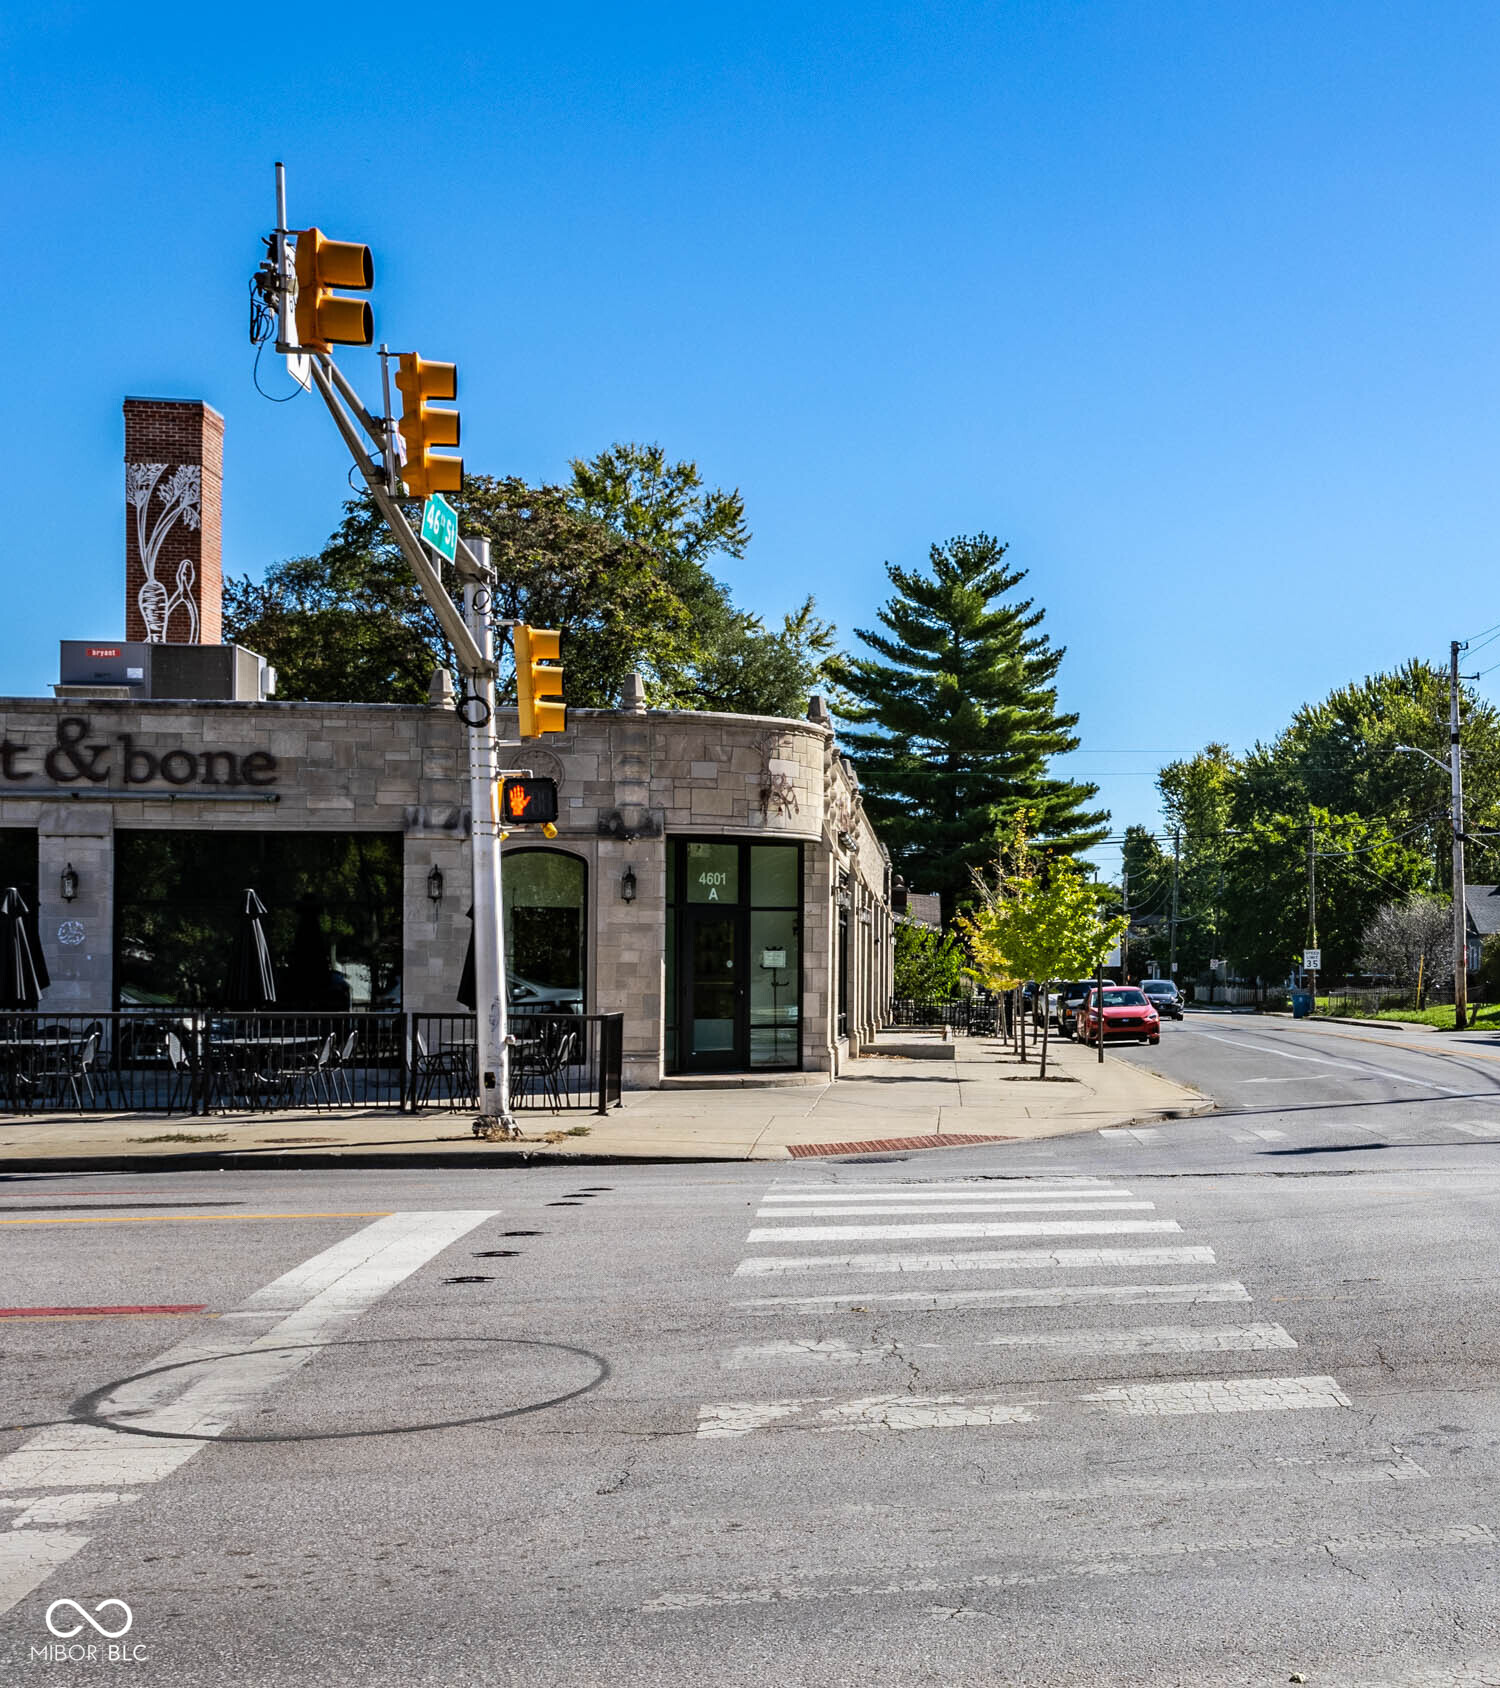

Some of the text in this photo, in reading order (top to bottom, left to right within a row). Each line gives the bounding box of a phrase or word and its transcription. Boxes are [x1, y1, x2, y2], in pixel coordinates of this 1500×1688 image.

[445, 519, 455, 548] St
[92, 649, 116, 657] bryant
[44, 717, 110, 782] &
[118, 733, 279, 785] bone
[699, 872, 727, 885] 4601
[708, 888, 719, 901] A
[1306, 960, 1318, 968] 35
